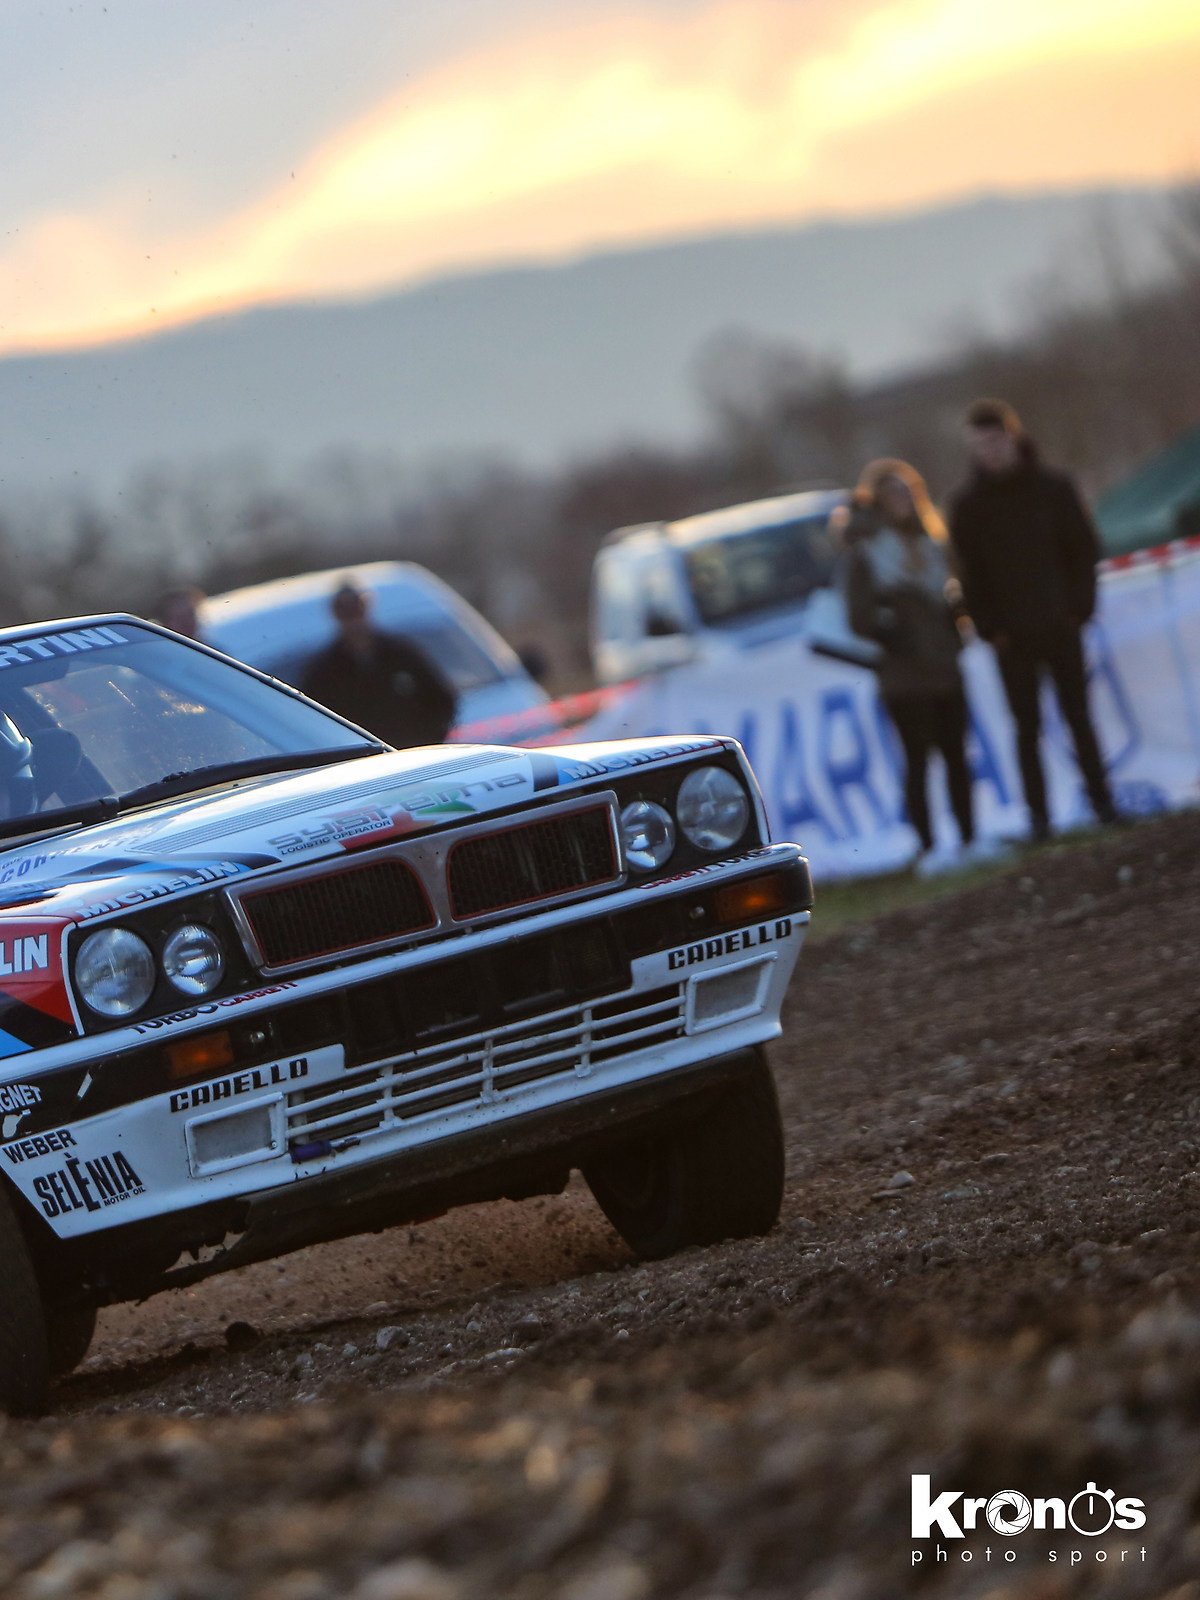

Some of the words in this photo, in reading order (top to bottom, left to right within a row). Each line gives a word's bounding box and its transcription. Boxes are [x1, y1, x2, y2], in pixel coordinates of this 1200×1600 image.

[281, 837, 331, 855] LOGISTIC
[333, 819, 393, 841] OPERATOR
[75, 859, 241, 919] MICHELIN
[668, 918, 792, 971] CARELLO
[170, 1057, 309, 1113] CARELLO
[2, 1128, 78, 1165] WEBER
[104, 1192, 131, 1206] MOTOR
[133, 1186, 146, 1196] OIL
